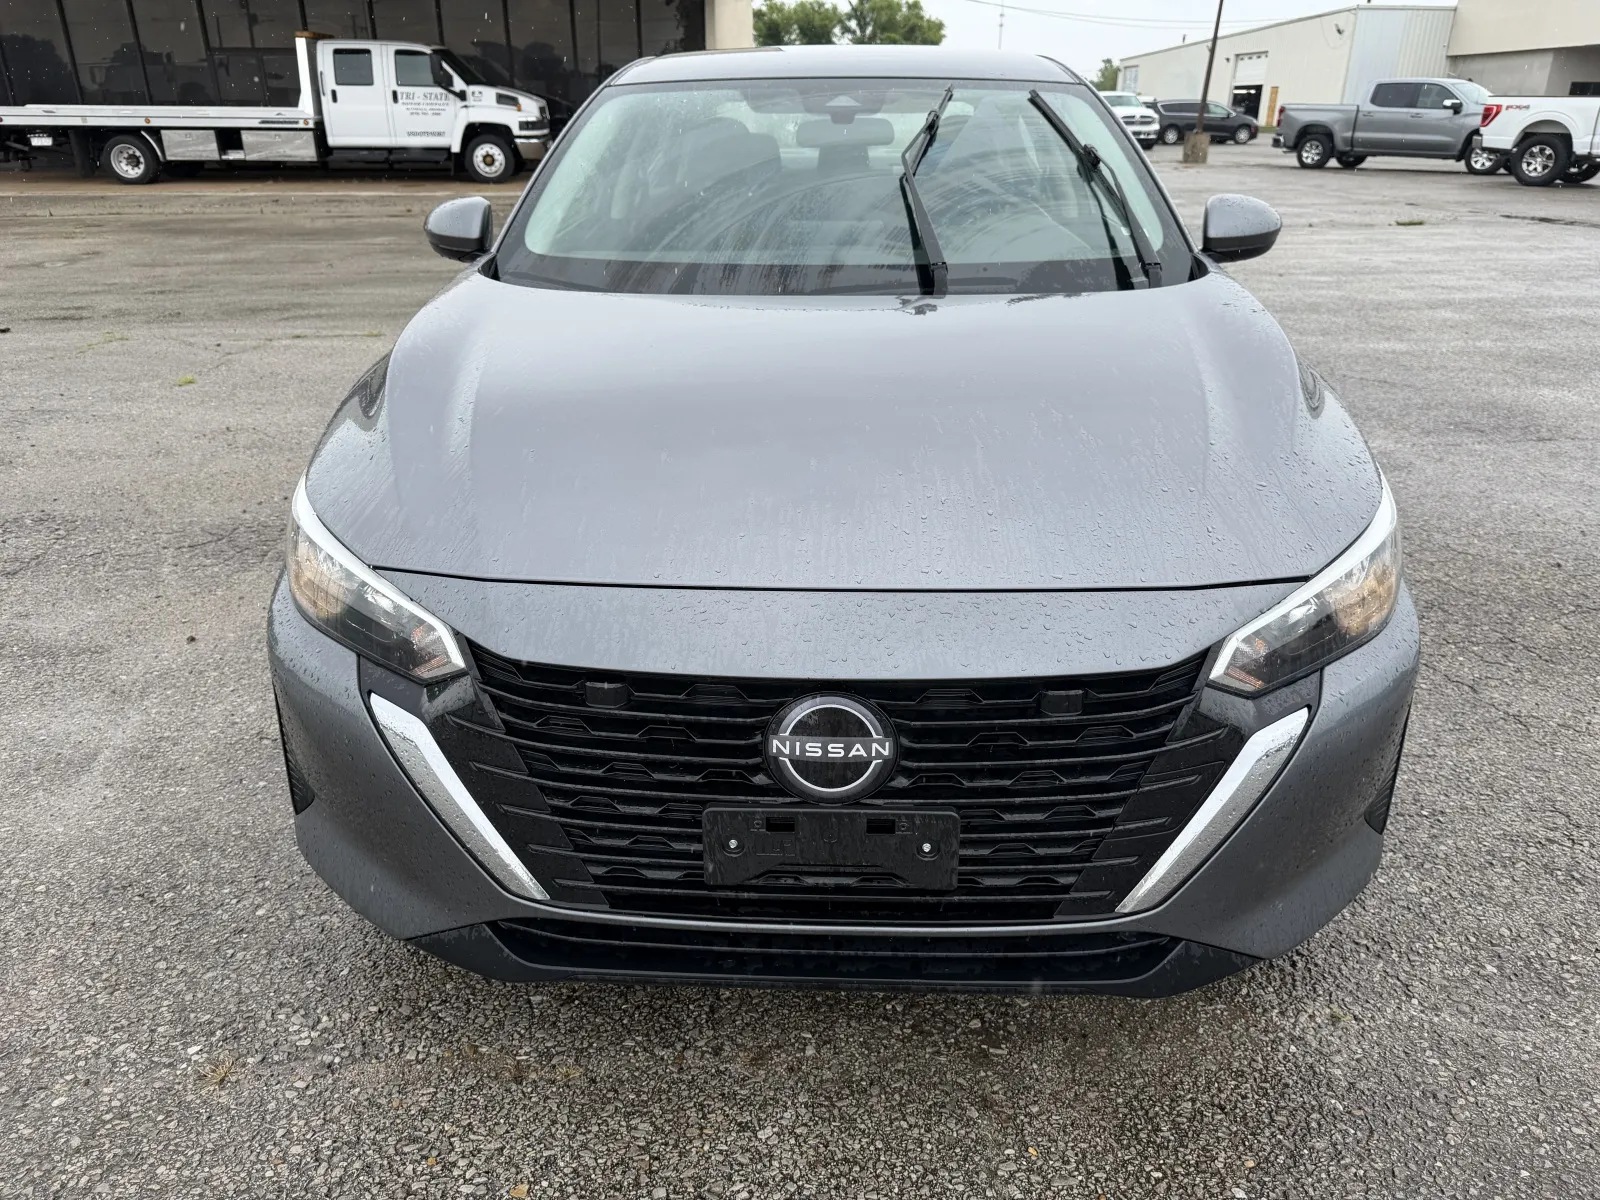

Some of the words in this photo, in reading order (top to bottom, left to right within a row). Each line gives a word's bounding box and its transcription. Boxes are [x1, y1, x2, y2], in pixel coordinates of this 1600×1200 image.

[400, 91, 415, 101] TRI
[422, 92, 450, 101] STATE
[772, 739, 890, 758] NISSAN
